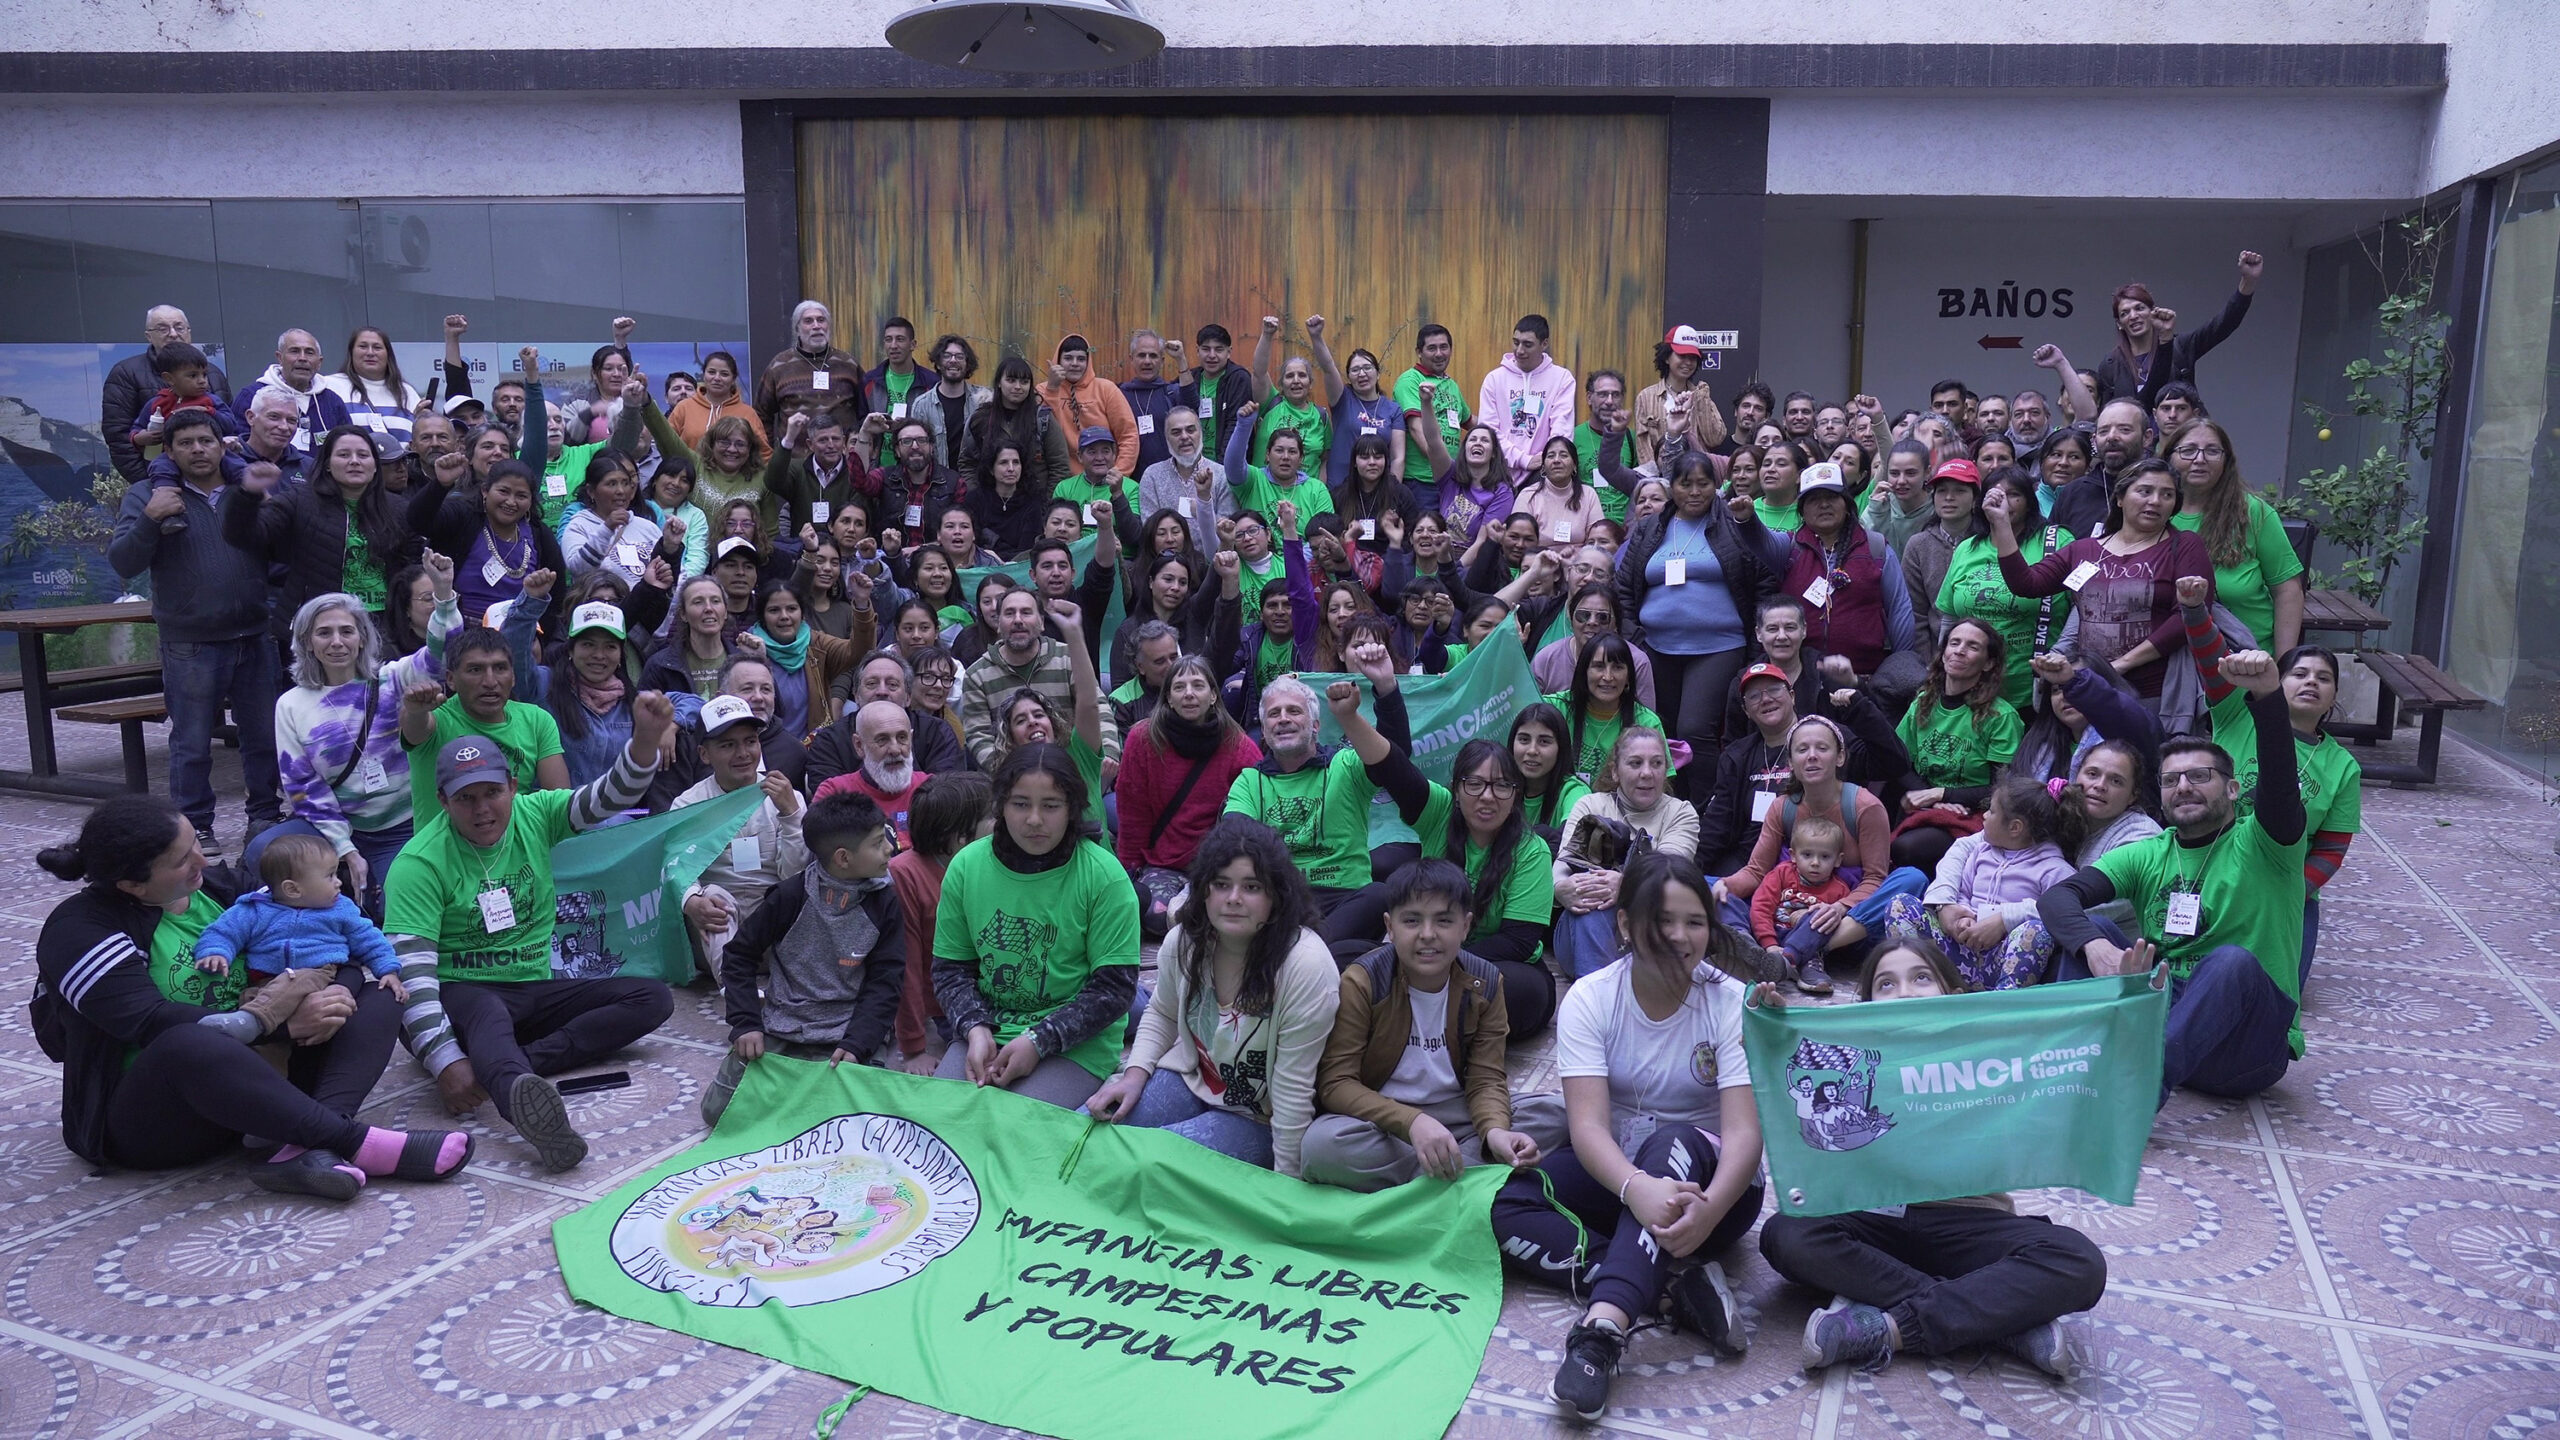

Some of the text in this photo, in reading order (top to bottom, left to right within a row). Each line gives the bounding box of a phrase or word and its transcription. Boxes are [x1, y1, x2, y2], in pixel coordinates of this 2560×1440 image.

[1937, 280, 2074, 318] BAÑOS
[1697, 333, 1718, 345] AÑOS
[1411, 708, 1480, 757] MNCI
[452, 948, 518, 969] MNCI
[2029, 1043, 2102, 1063] somos
[2029, 1060, 2089, 1080] tierra
[1900, 1058, 2024, 1094] MNCI
[1905, 1100, 1928, 1113] Vía
[1932, 1093, 2016, 1112] Campesina
[2032, 1083, 2099, 1099] Argentina
[995, 1207, 1470, 1315] INFANCIAS LIBRES
[1018, 1262, 1366, 1345] CAMPESINAS
[963, 1291, 1357, 1394] Y POPULARES
